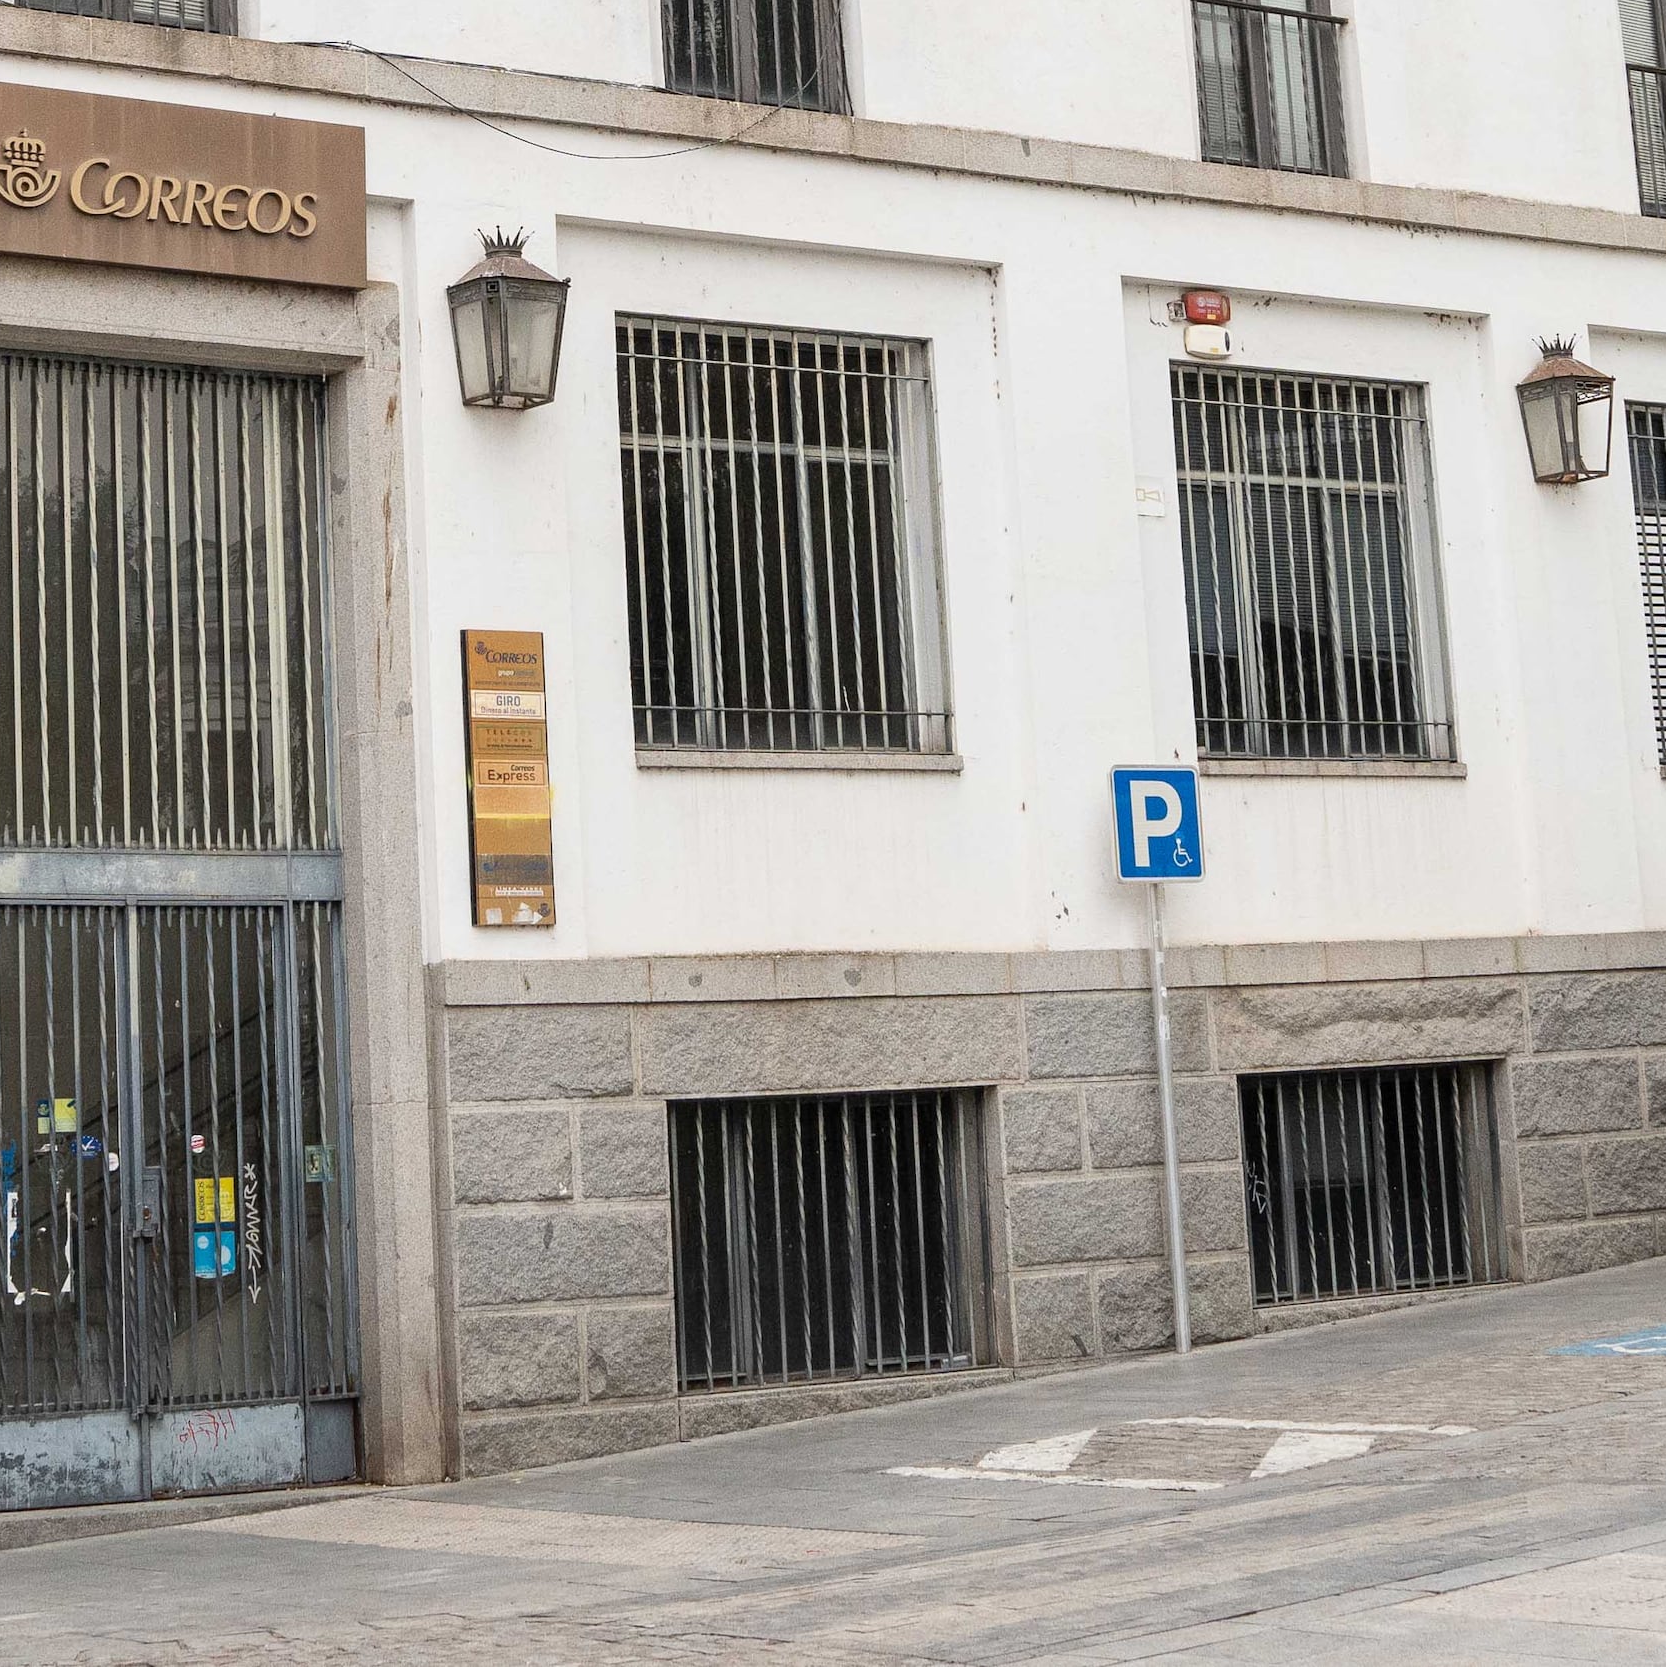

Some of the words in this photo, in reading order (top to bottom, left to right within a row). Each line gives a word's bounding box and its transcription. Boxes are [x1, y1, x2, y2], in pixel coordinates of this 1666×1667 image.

[70, 157, 319, 238] CORREOS
[486, 650, 537, 664] CORREOS
[496, 696, 521, 707] GIRO
[511, 764, 535, 772] Correos
[488, 769, 536, 782] Express
[1129, 780, 1183, 867] P
